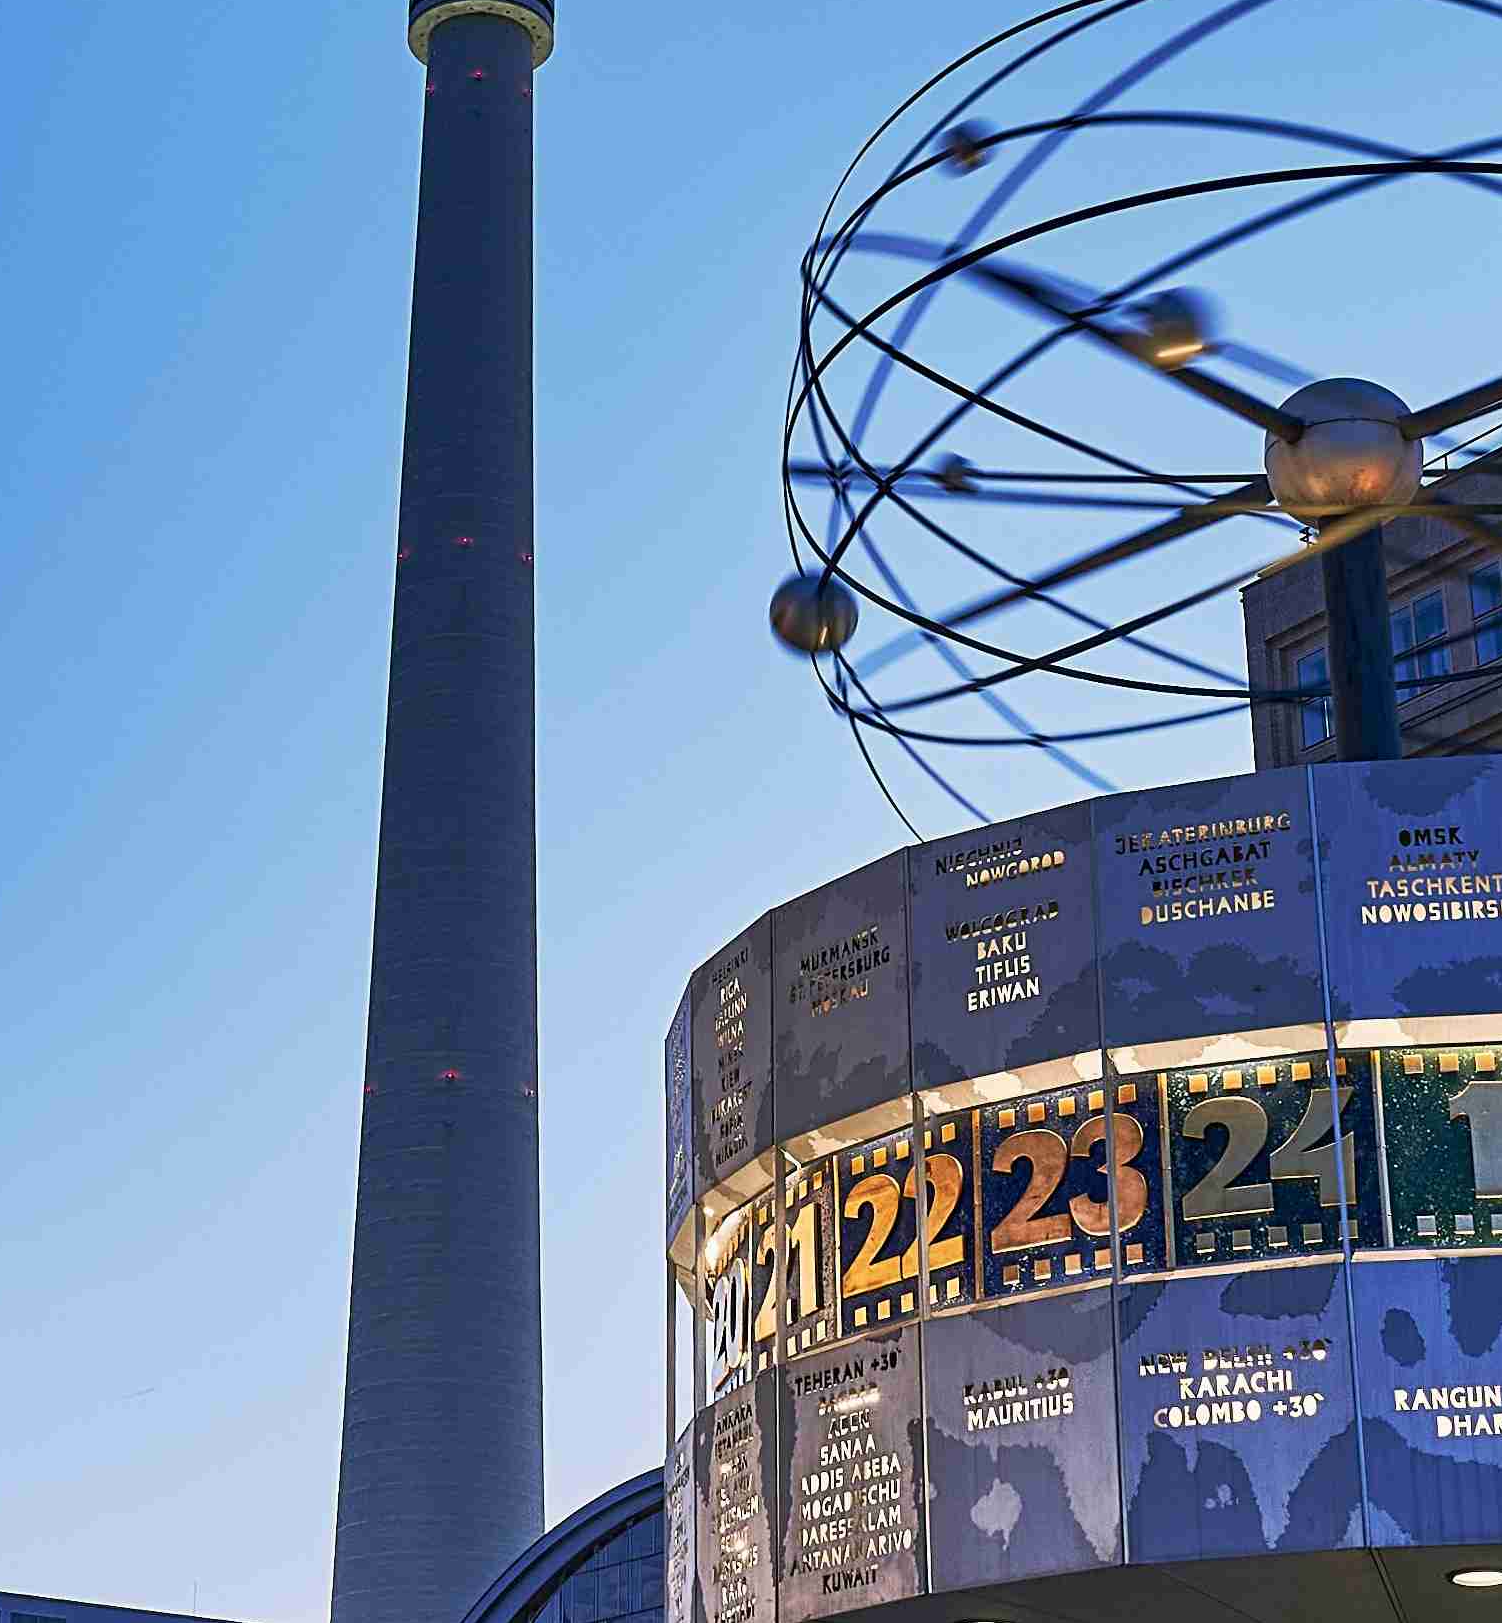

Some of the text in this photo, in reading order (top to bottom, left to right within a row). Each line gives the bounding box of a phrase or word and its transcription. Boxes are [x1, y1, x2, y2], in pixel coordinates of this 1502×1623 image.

[1115, 813, 1291, 855] JEKATERINBURG
[1399, 826, 1464, 847] OMSK
[965, 849, 1065, 888] NOWGOROD
[1138, 841, 1271, 876] ASCHGABAT
[1388, 850, 1481, 873] ALMATY
[1140, 889, 1275, 925] DUSCHANBE
[799, 925, 879, 974] MURMANSK
[976, 932, 1027, 960] BAKU
[975, 955, 1031, 985] TIFLIS
[720, 977, 740, 1005] RIGA
[967, 977, 1040, 1012] ERIWAN
[1182, 1086, 1356, 1221] 24
[991, 1113, 1148, 1255] 23
[843, 1153, 964, 1299] 22
[754, 1202, 823, 1343] 21
[795, 1359, 864, 1397] TEHERAN
[1138, 1352, 1189, 1377] NEW
[963, 1374, 1029, 1406] KABUL
[1179, 1370, 1293, 1400] KARACHI
[1394, 1384, 1502, 1411] RANGUN
[967, 1392, 1074, 1432] MAURITIUS
[1153, 1397, 1262, 1428] COLOMBO
[820, 1434, 877, 1466] SANAA
[801, 1452, 902, 1497] ADDIS ABEBA
[800, 1478, 901, 1522] MOGADISCHU
[822, 1564, 879, 1595] KUWAIT
